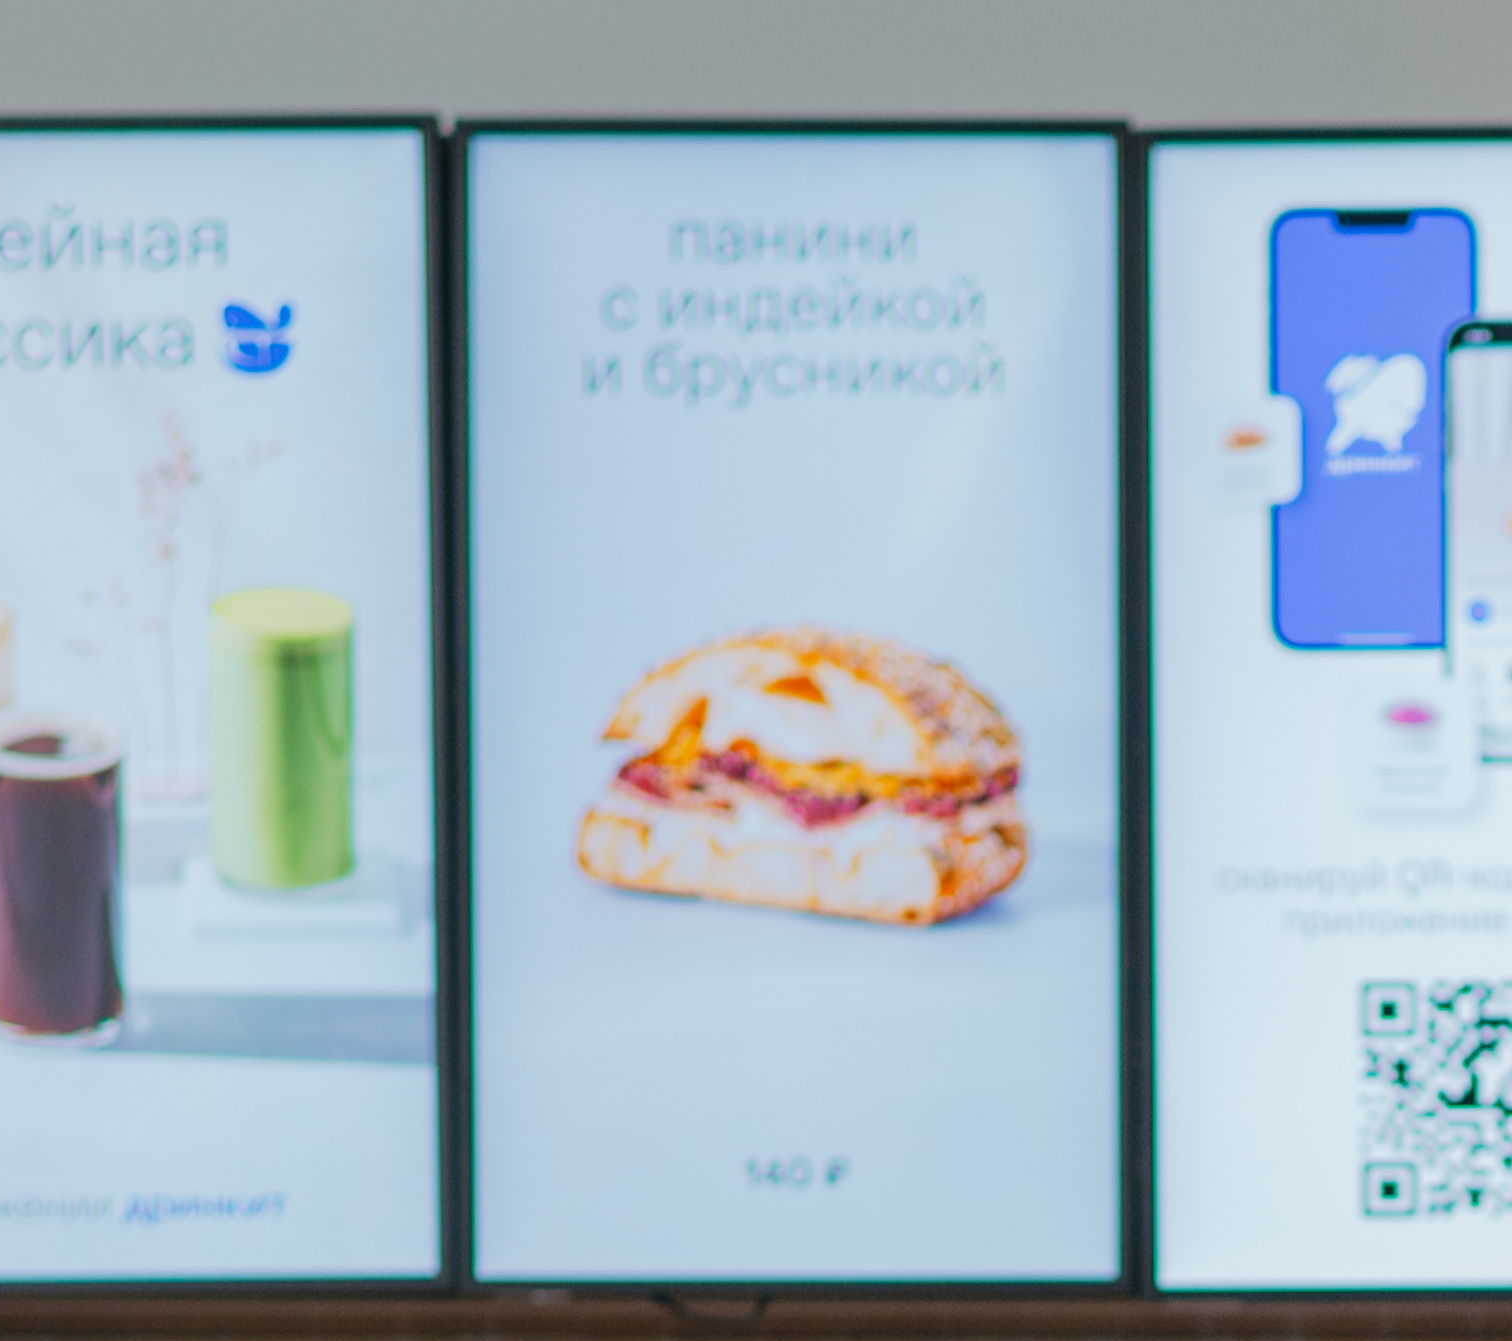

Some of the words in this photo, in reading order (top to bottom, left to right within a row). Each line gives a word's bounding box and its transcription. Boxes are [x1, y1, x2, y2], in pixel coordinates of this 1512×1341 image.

[668, 217, 918, 265] панини
[599, 283, 640, 331] с
[656, 271, 987, 340] индейкой
[581, 352, 623, 398] и
[642, 337, 1006, 413] брусникой
[744, 1154, 815, 1191] 140
[121, 1191, 290, 1232] дринкит
